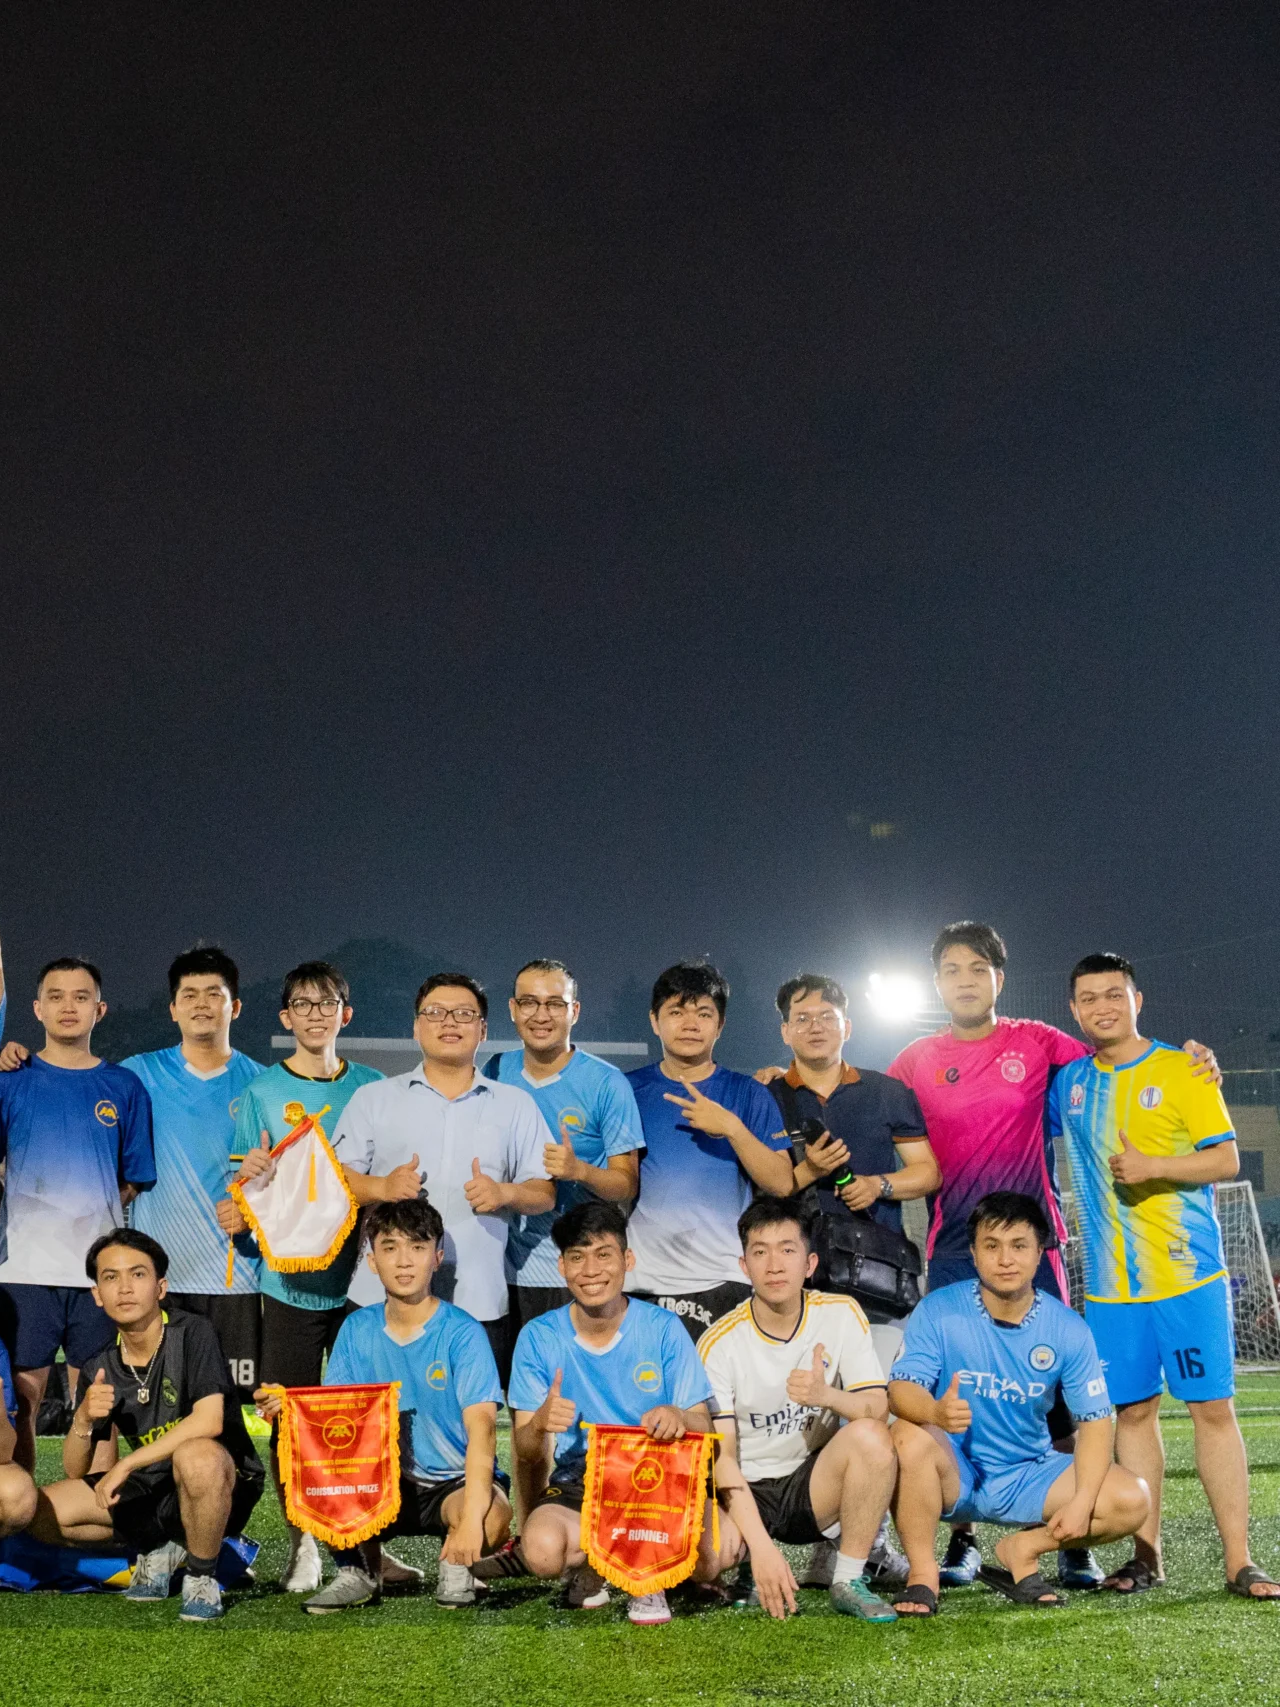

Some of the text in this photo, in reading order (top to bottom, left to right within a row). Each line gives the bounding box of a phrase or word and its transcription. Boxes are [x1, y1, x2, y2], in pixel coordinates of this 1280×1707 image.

[228, 1358, 255, 1386] 18
[1172, 1347, 1206, 1380] 16
[778, 1415, 815, 1435] BETER
[306, 1483, 379, 1497] CONSOLATION PRIZE
[628, 1529, 669, 1544] RUNNER
